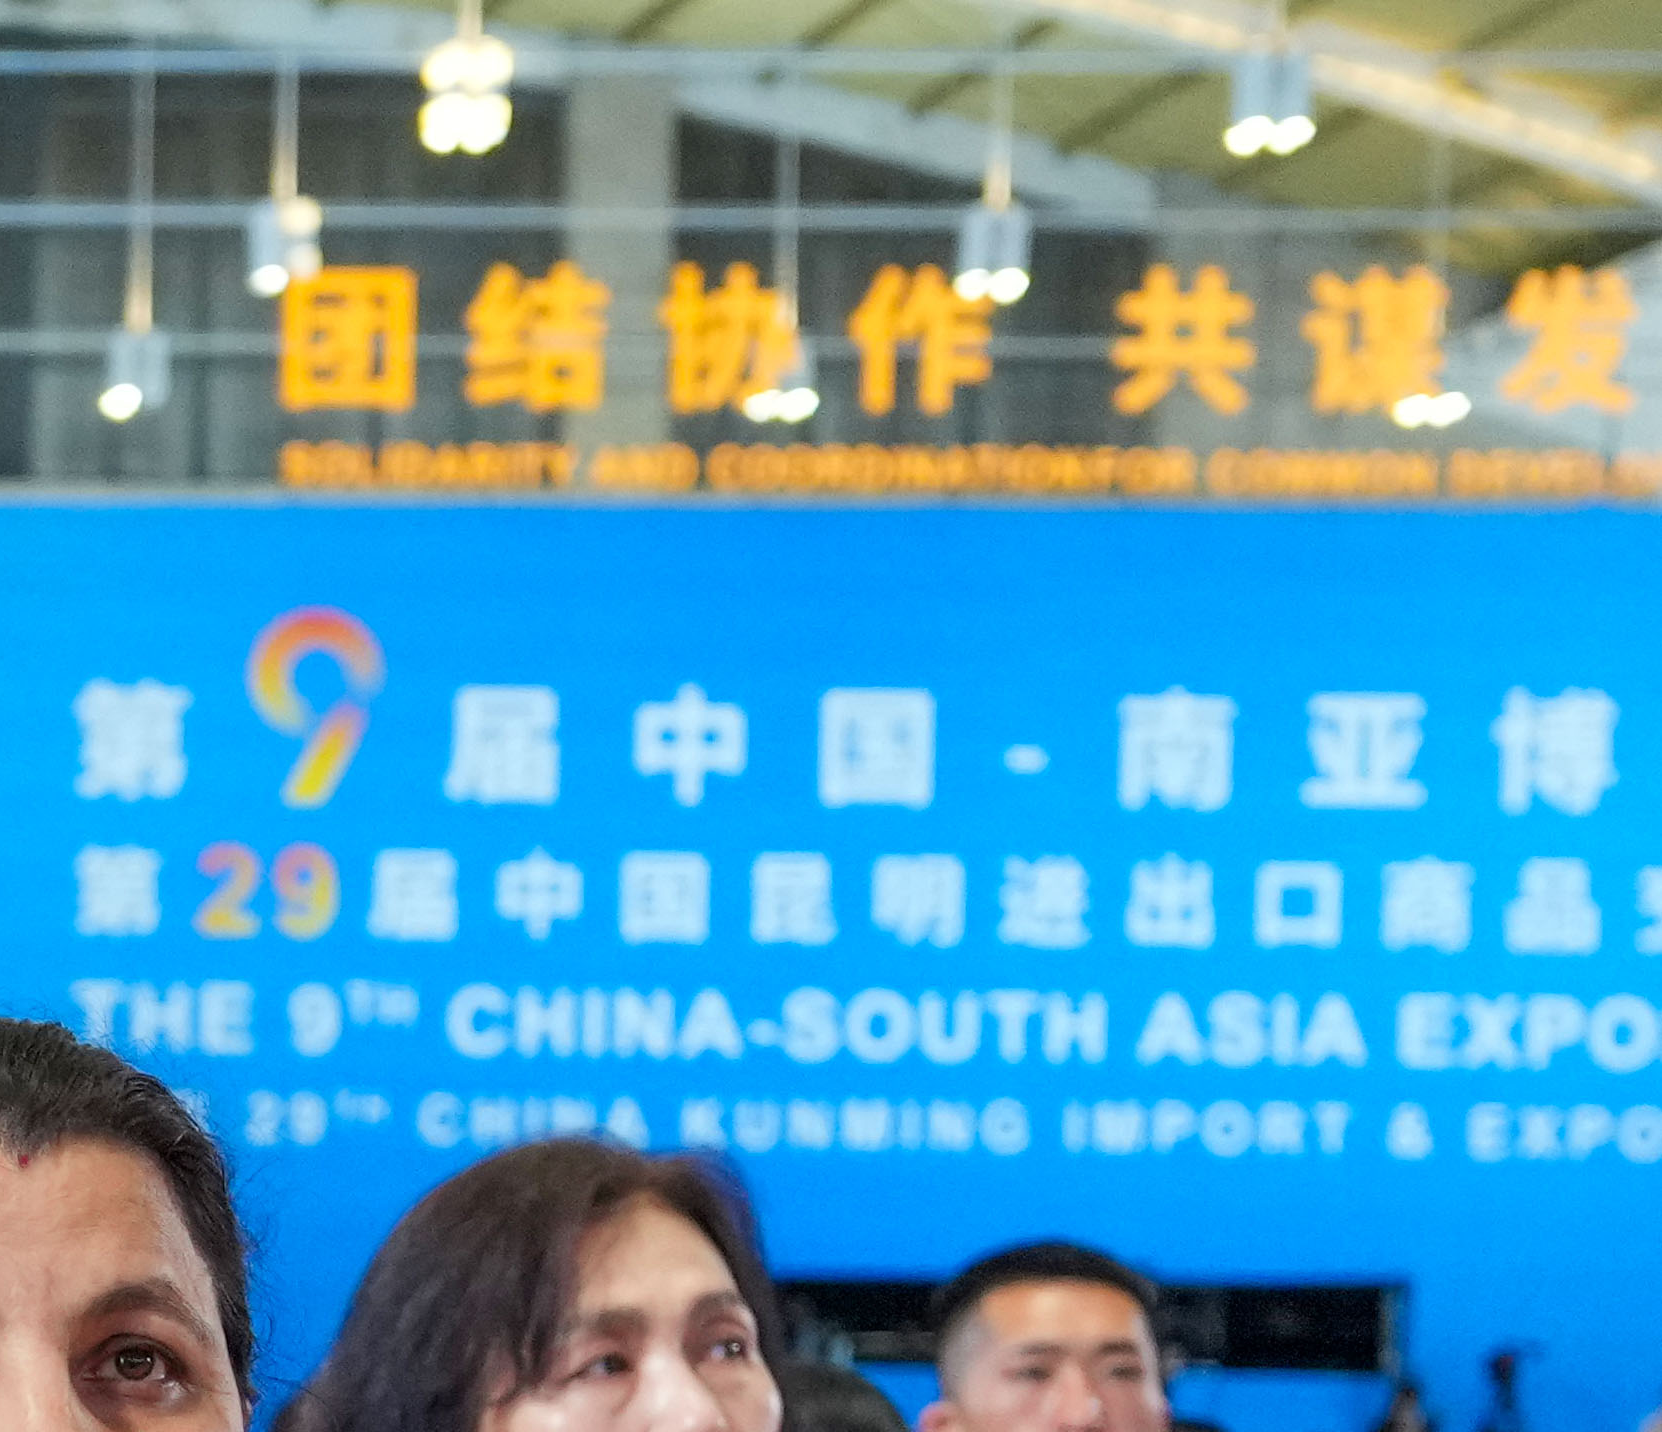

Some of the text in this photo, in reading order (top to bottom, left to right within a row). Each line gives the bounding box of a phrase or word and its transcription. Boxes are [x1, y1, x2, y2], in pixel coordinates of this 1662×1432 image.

[278, 261, 994, 416] 团结协作
[72, 838, 1662, 956] 第29届中国昆明进出口商品
[70, 978, 255, 1056] THE
[287, 978, 419, 1058] 9TH
[444, 981, 1108, 1065] CHINA-SOUTH
[1135, 989, 1369, 1068] ASIA
[416, 1090, 649, 1149] CHINA
[680, 1093, 1030, 1156] KUNMING
[1062, 1097, 1351, 1157] IMPORT
[1386, 1101, 1434, 1160] &
